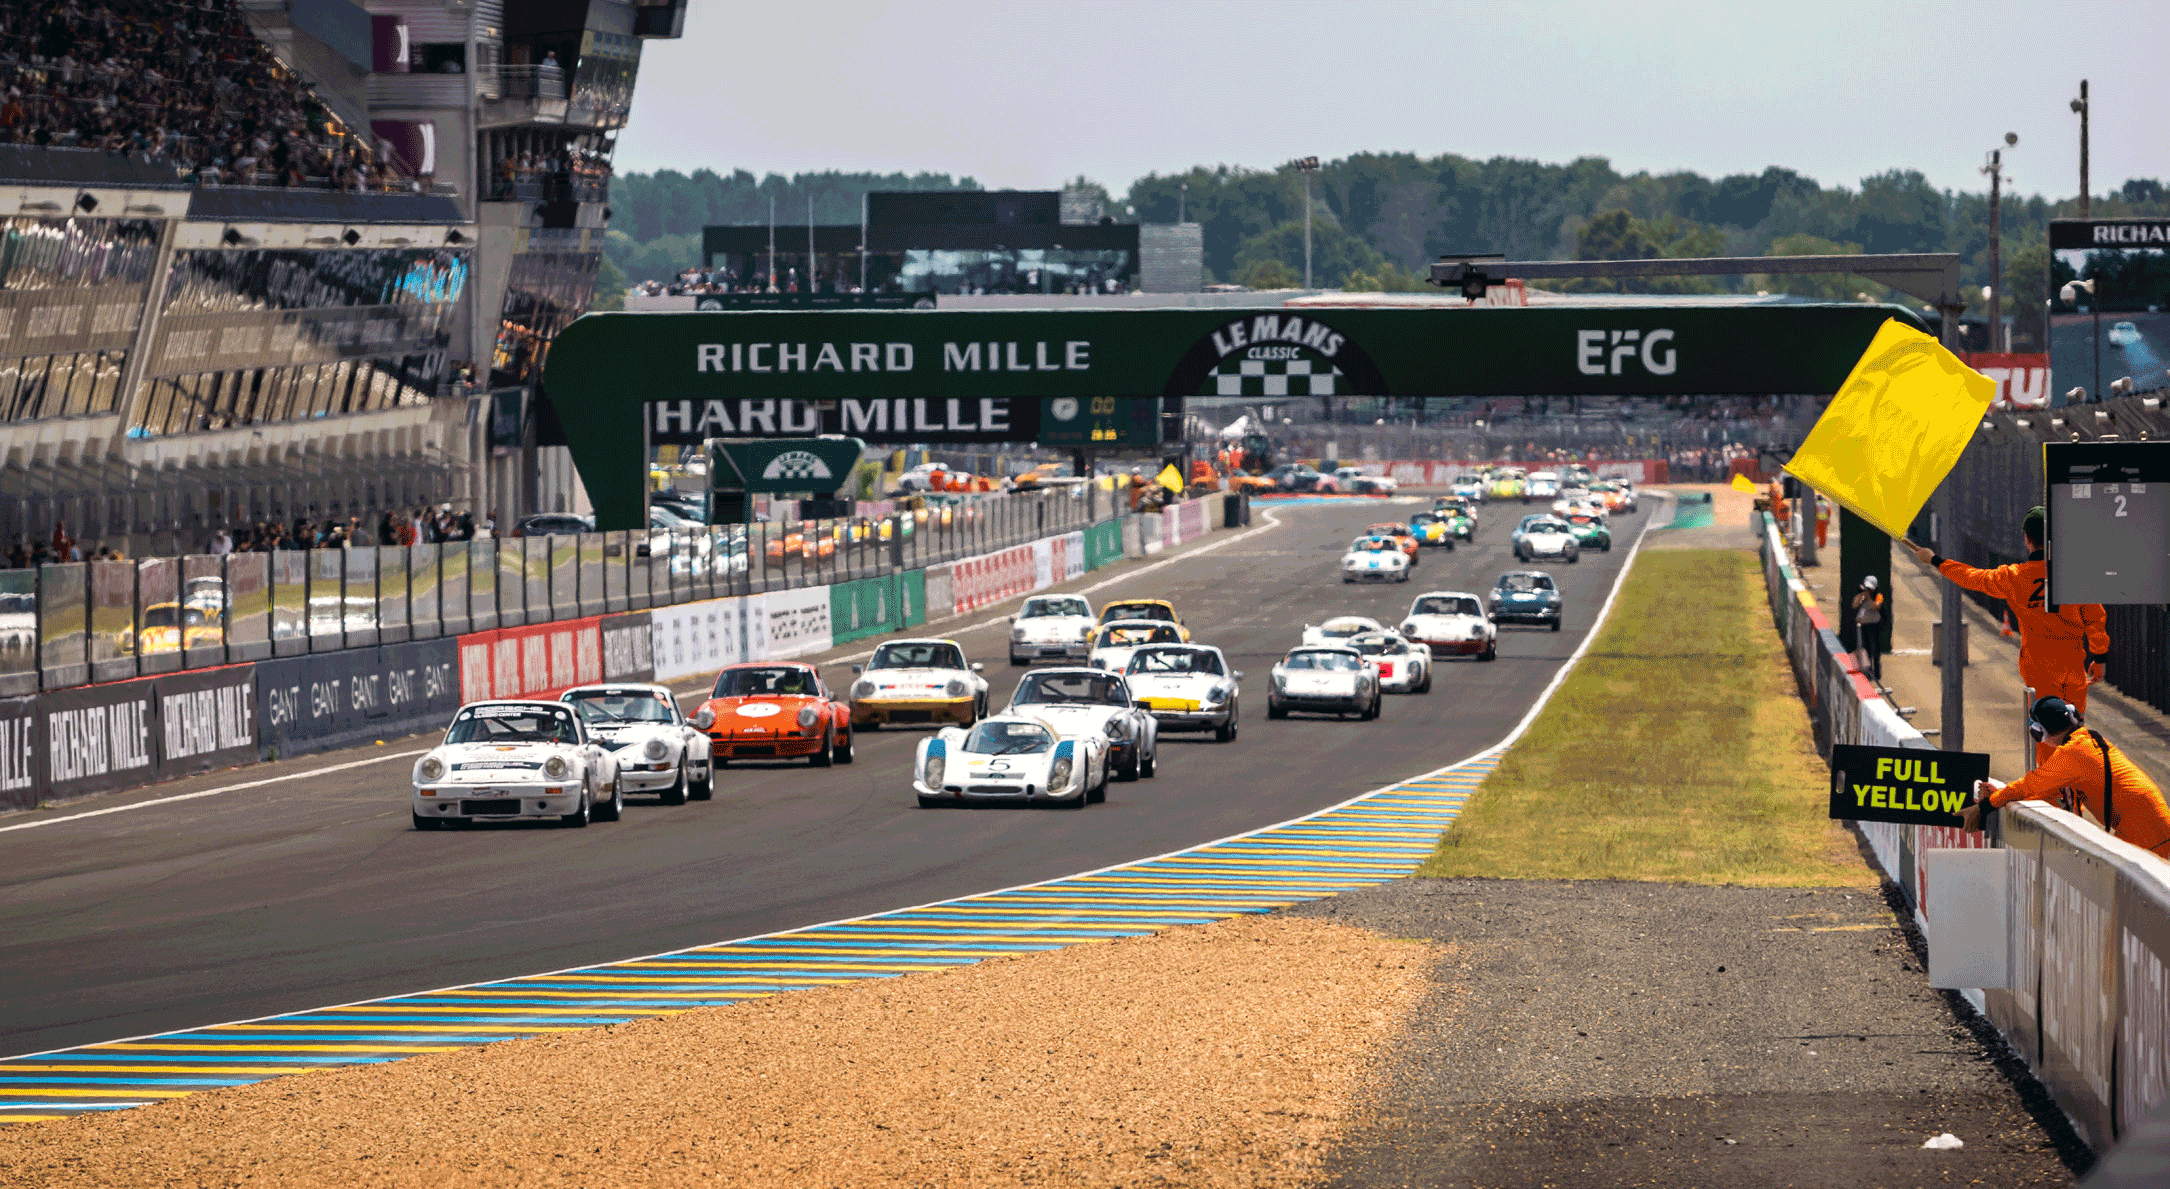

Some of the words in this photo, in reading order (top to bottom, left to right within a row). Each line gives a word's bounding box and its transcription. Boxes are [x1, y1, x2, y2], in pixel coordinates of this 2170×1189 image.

[2092, 225, 2170, 242] RICHA
[1211, 320, 1248, 358] LE
[1250, 314, 1345, 357] MANS
[1247, 346, 1300, 359] CLASSIC
[1577, 328, 1677, 376] EFG
[697, 342, 914, 373] RICHARD
[943, 341, 1090, 371] MILLE
[841, 398, 1010, 433] MILLE
[2114, 495, 2128, 517] 2
[351, 674, 379, 711] GANT
[389, 669, 416, 705] GANT
[425, 664, 450, 698] GANT
[269, 685, 300, 726] GANT
[311, 679, 340, 719] GANT
[163, 689, 216, 761] RICHARD
[216, 683, 252, 750] MILLE
[49, 706, 108, 784] RICHARD
[109, 700, 149, 771] MILLE
[988, 758, 1011, 771] 5
[1876, 757, 1946, 785] FULL
[1852, 783, 1967, 813] YELLOW
